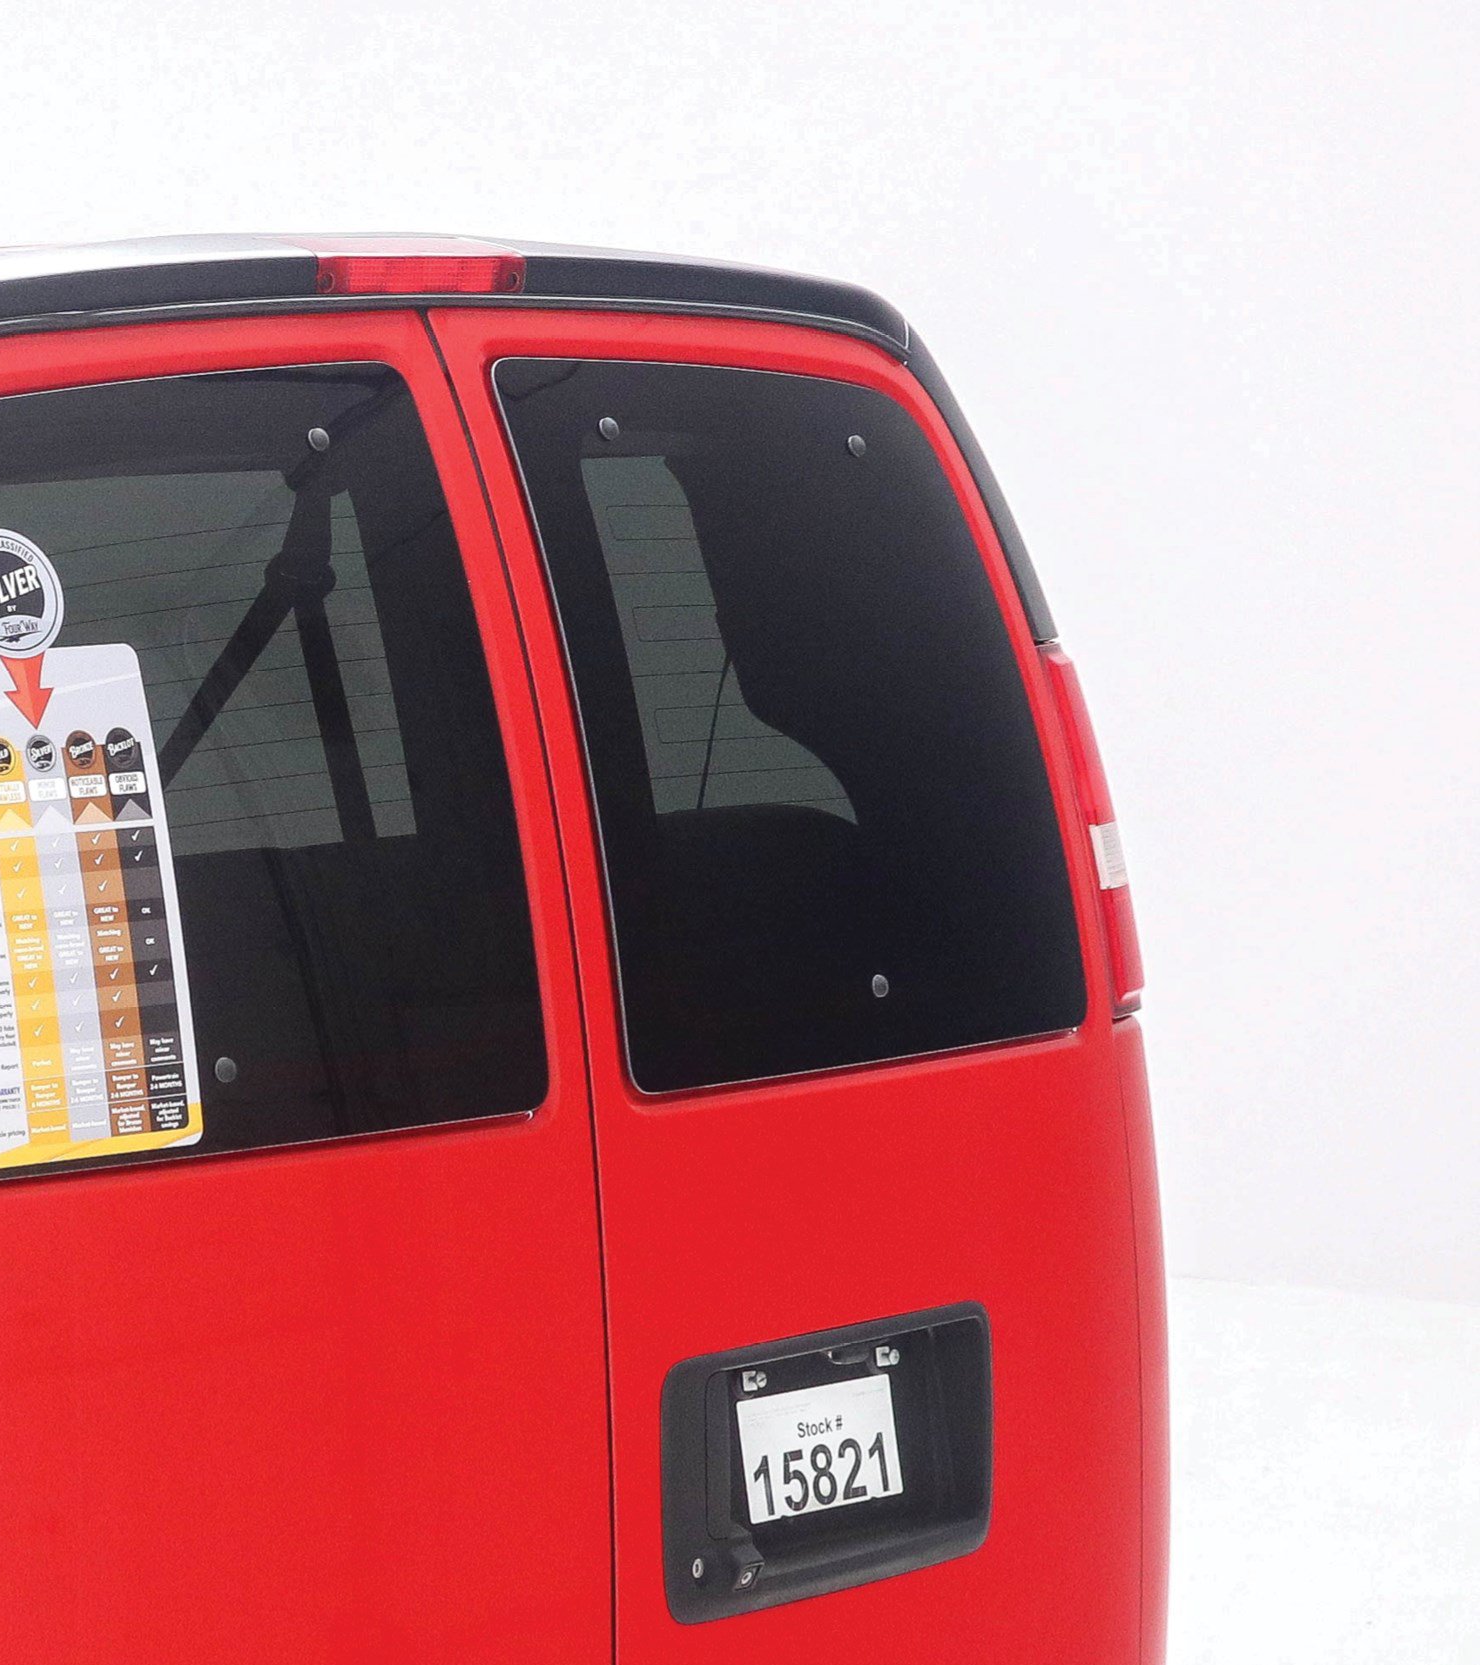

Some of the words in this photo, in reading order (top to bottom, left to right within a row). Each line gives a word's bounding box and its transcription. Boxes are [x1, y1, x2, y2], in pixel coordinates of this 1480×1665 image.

[797, 1417, 833, 1438] Stock
[835, 1415, 843, 1431] #
[753, 1432, 890, 1516] 15821
